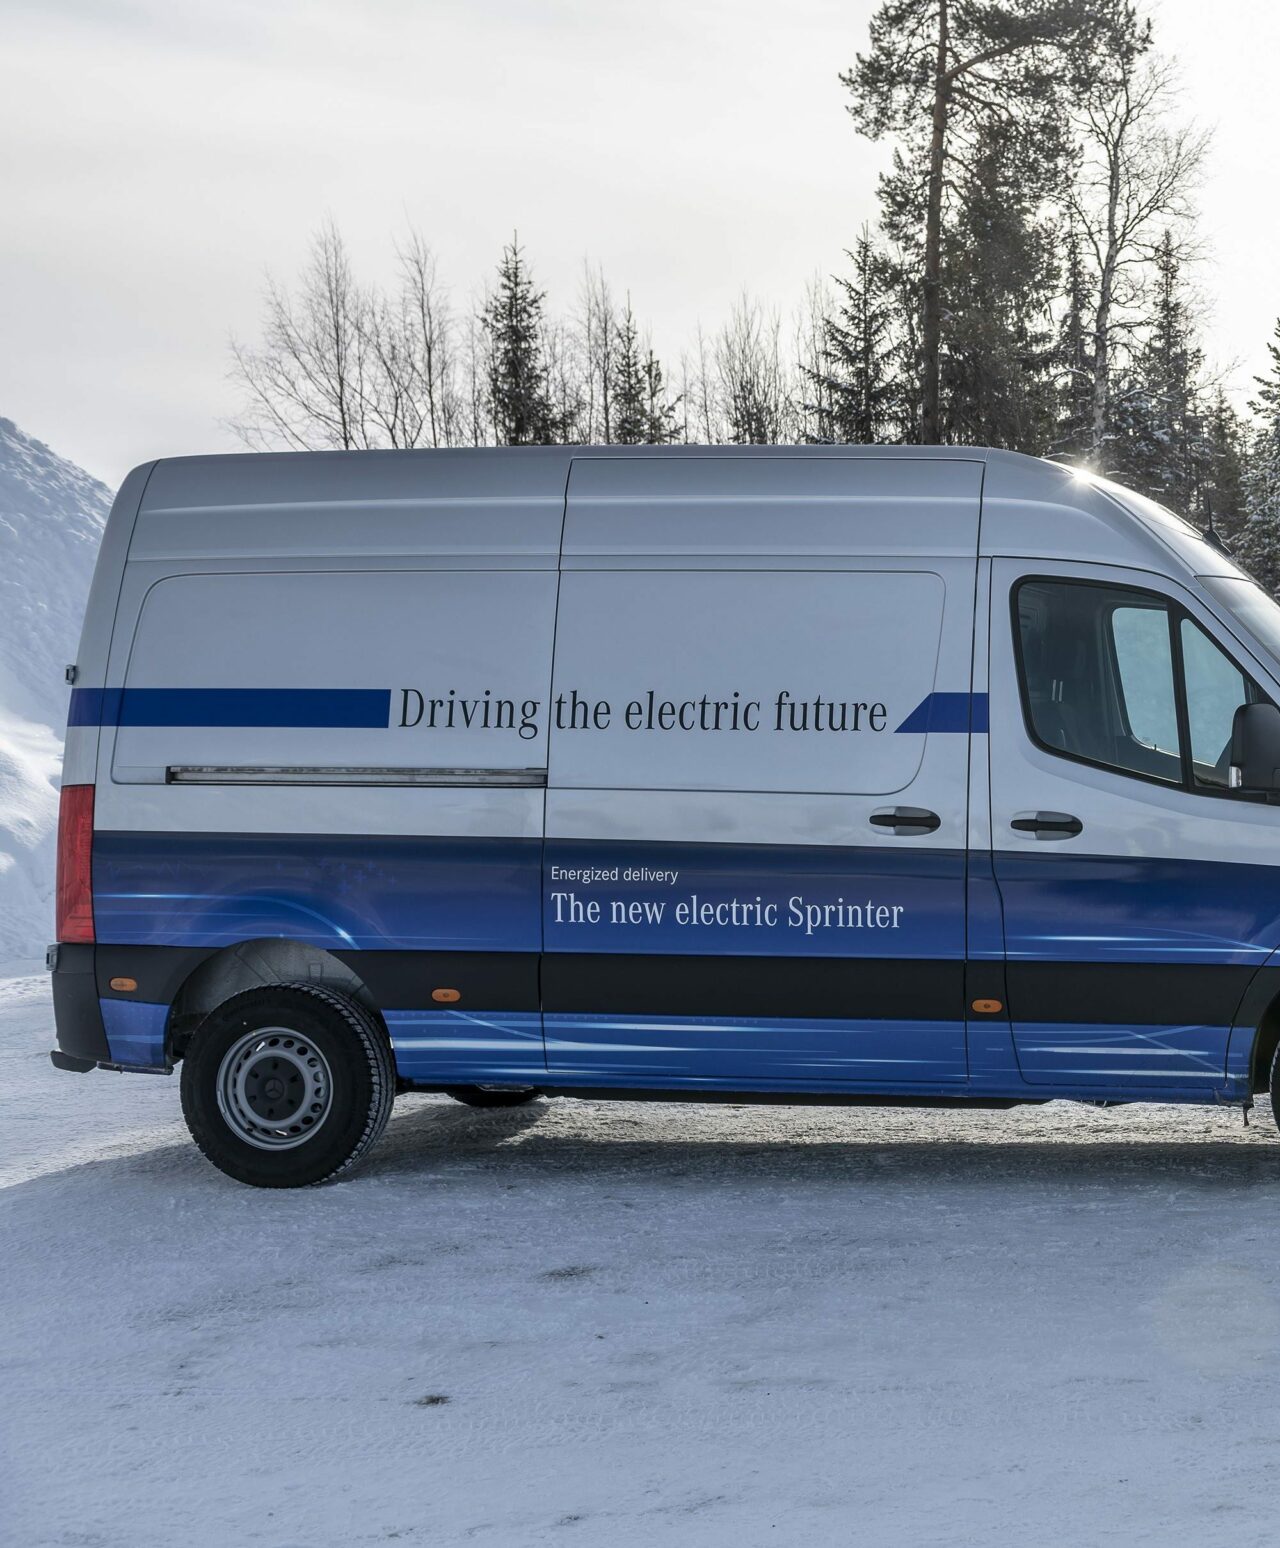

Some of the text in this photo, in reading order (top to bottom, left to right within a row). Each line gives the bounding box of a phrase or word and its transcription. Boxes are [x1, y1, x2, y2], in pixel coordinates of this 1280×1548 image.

[398, 688, 888, 740] Driving the electric future
[551, 866, 679, 885] Energized delivery
[551, 892, 904, 935] The new electric Sprinter
